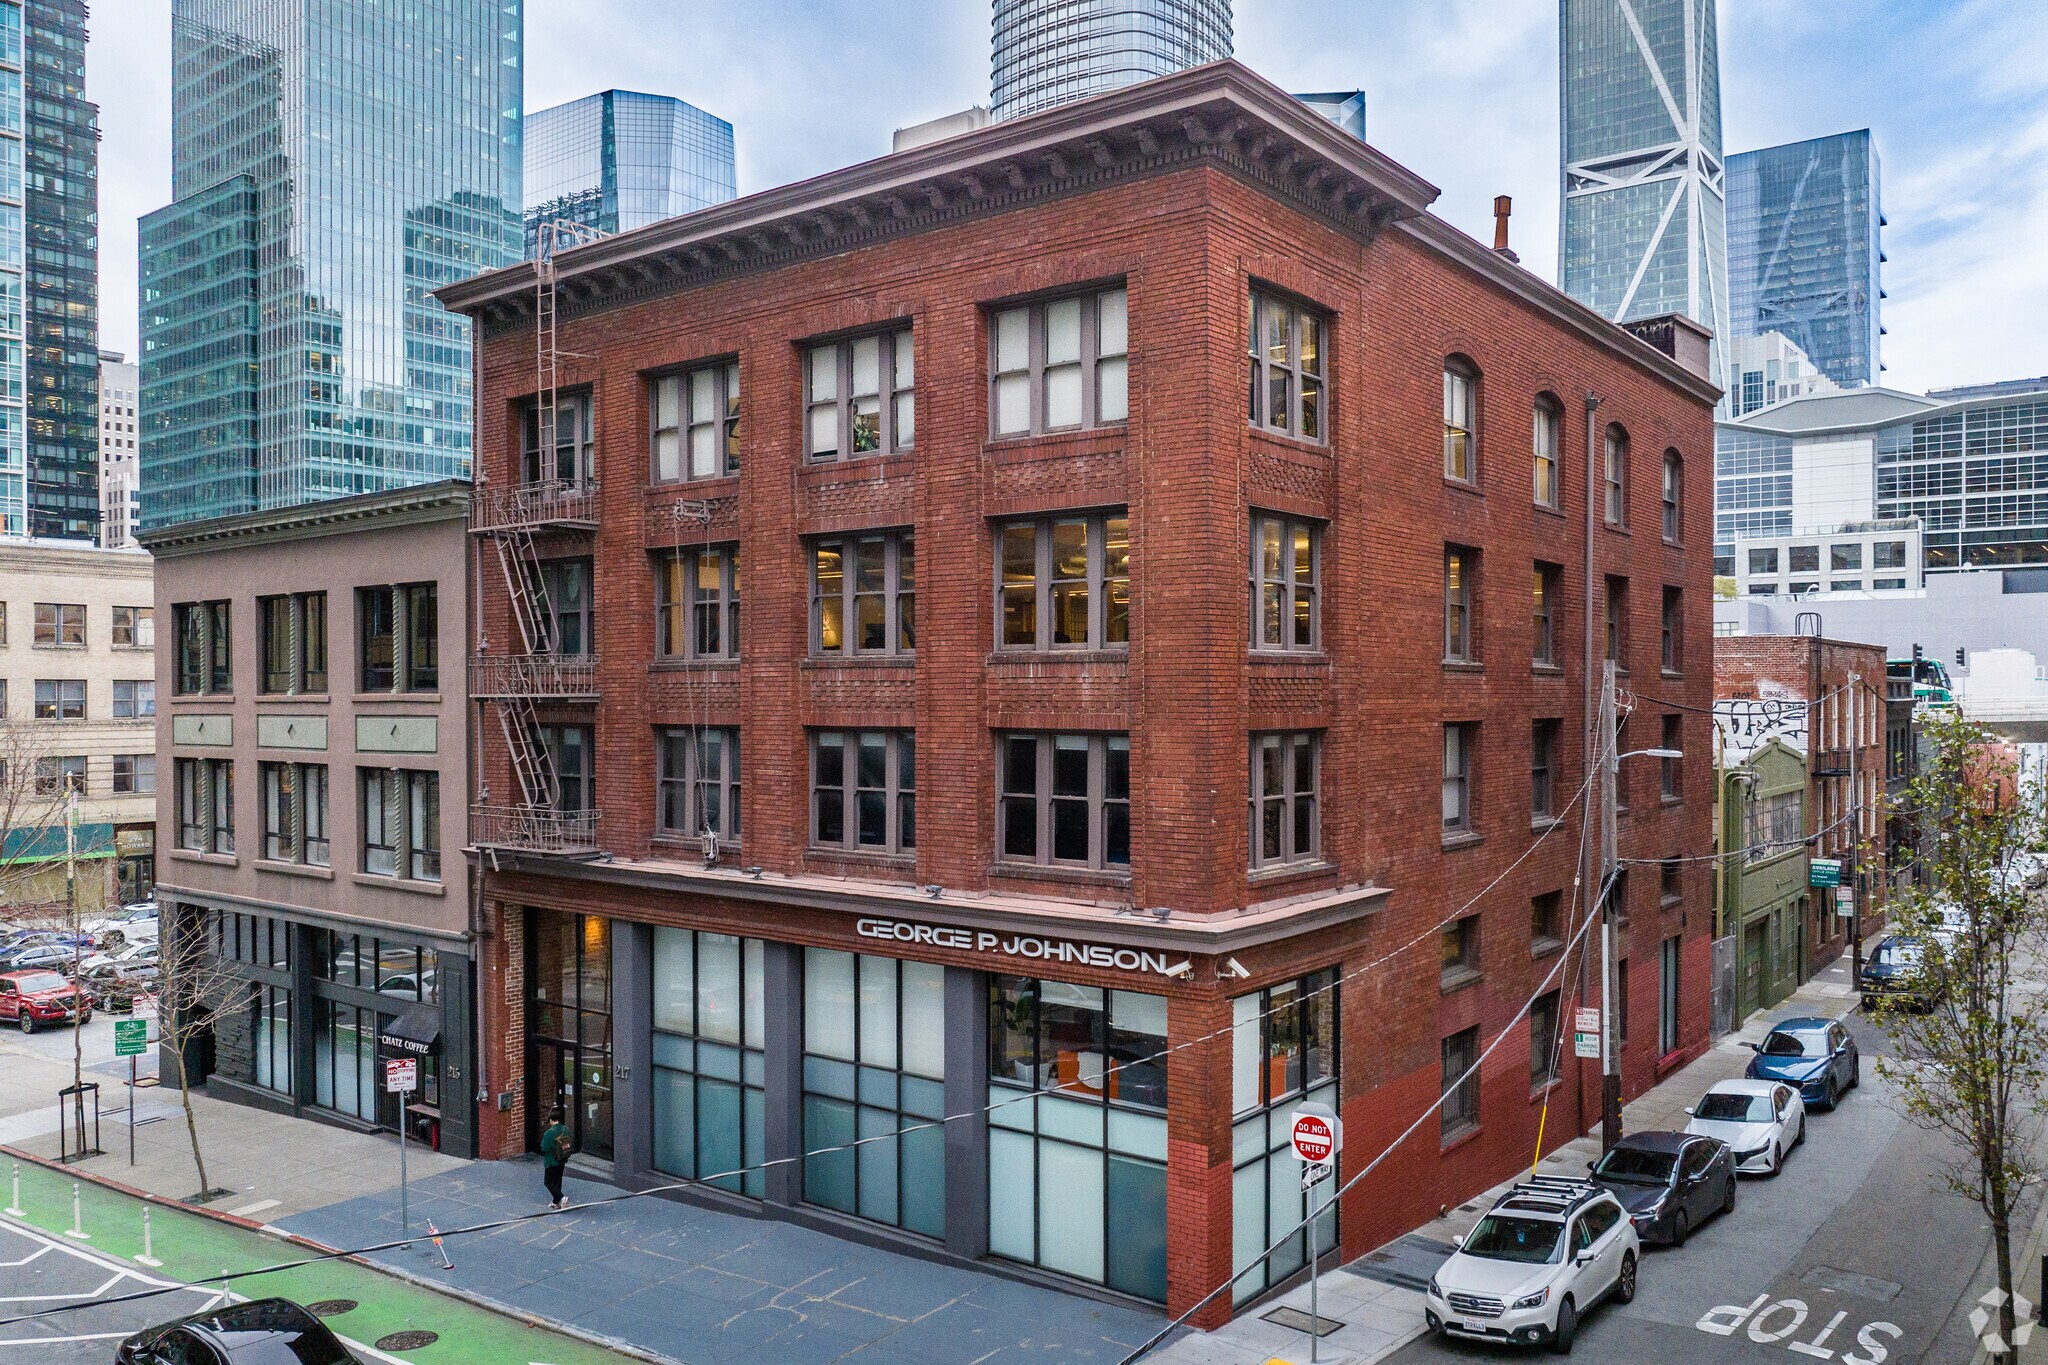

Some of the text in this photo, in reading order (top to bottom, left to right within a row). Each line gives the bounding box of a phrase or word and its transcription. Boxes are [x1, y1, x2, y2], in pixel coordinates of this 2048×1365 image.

[856, 918, 1167, 974] GEORGE P. JOHNSON
[382, 1035, 429, 1054] CHATZ COFFEE
[447, 1065, 460, 1079] 215
[615, 1064, 630, 1080] 217
[1298, 1122, 1328, 1135] DO NOT
[1300, 1143, 1326, 1155] ENTER
[1310, 1169, 1320, 1181] ONE
[1696, 1293, 1904, 1365] STOP
